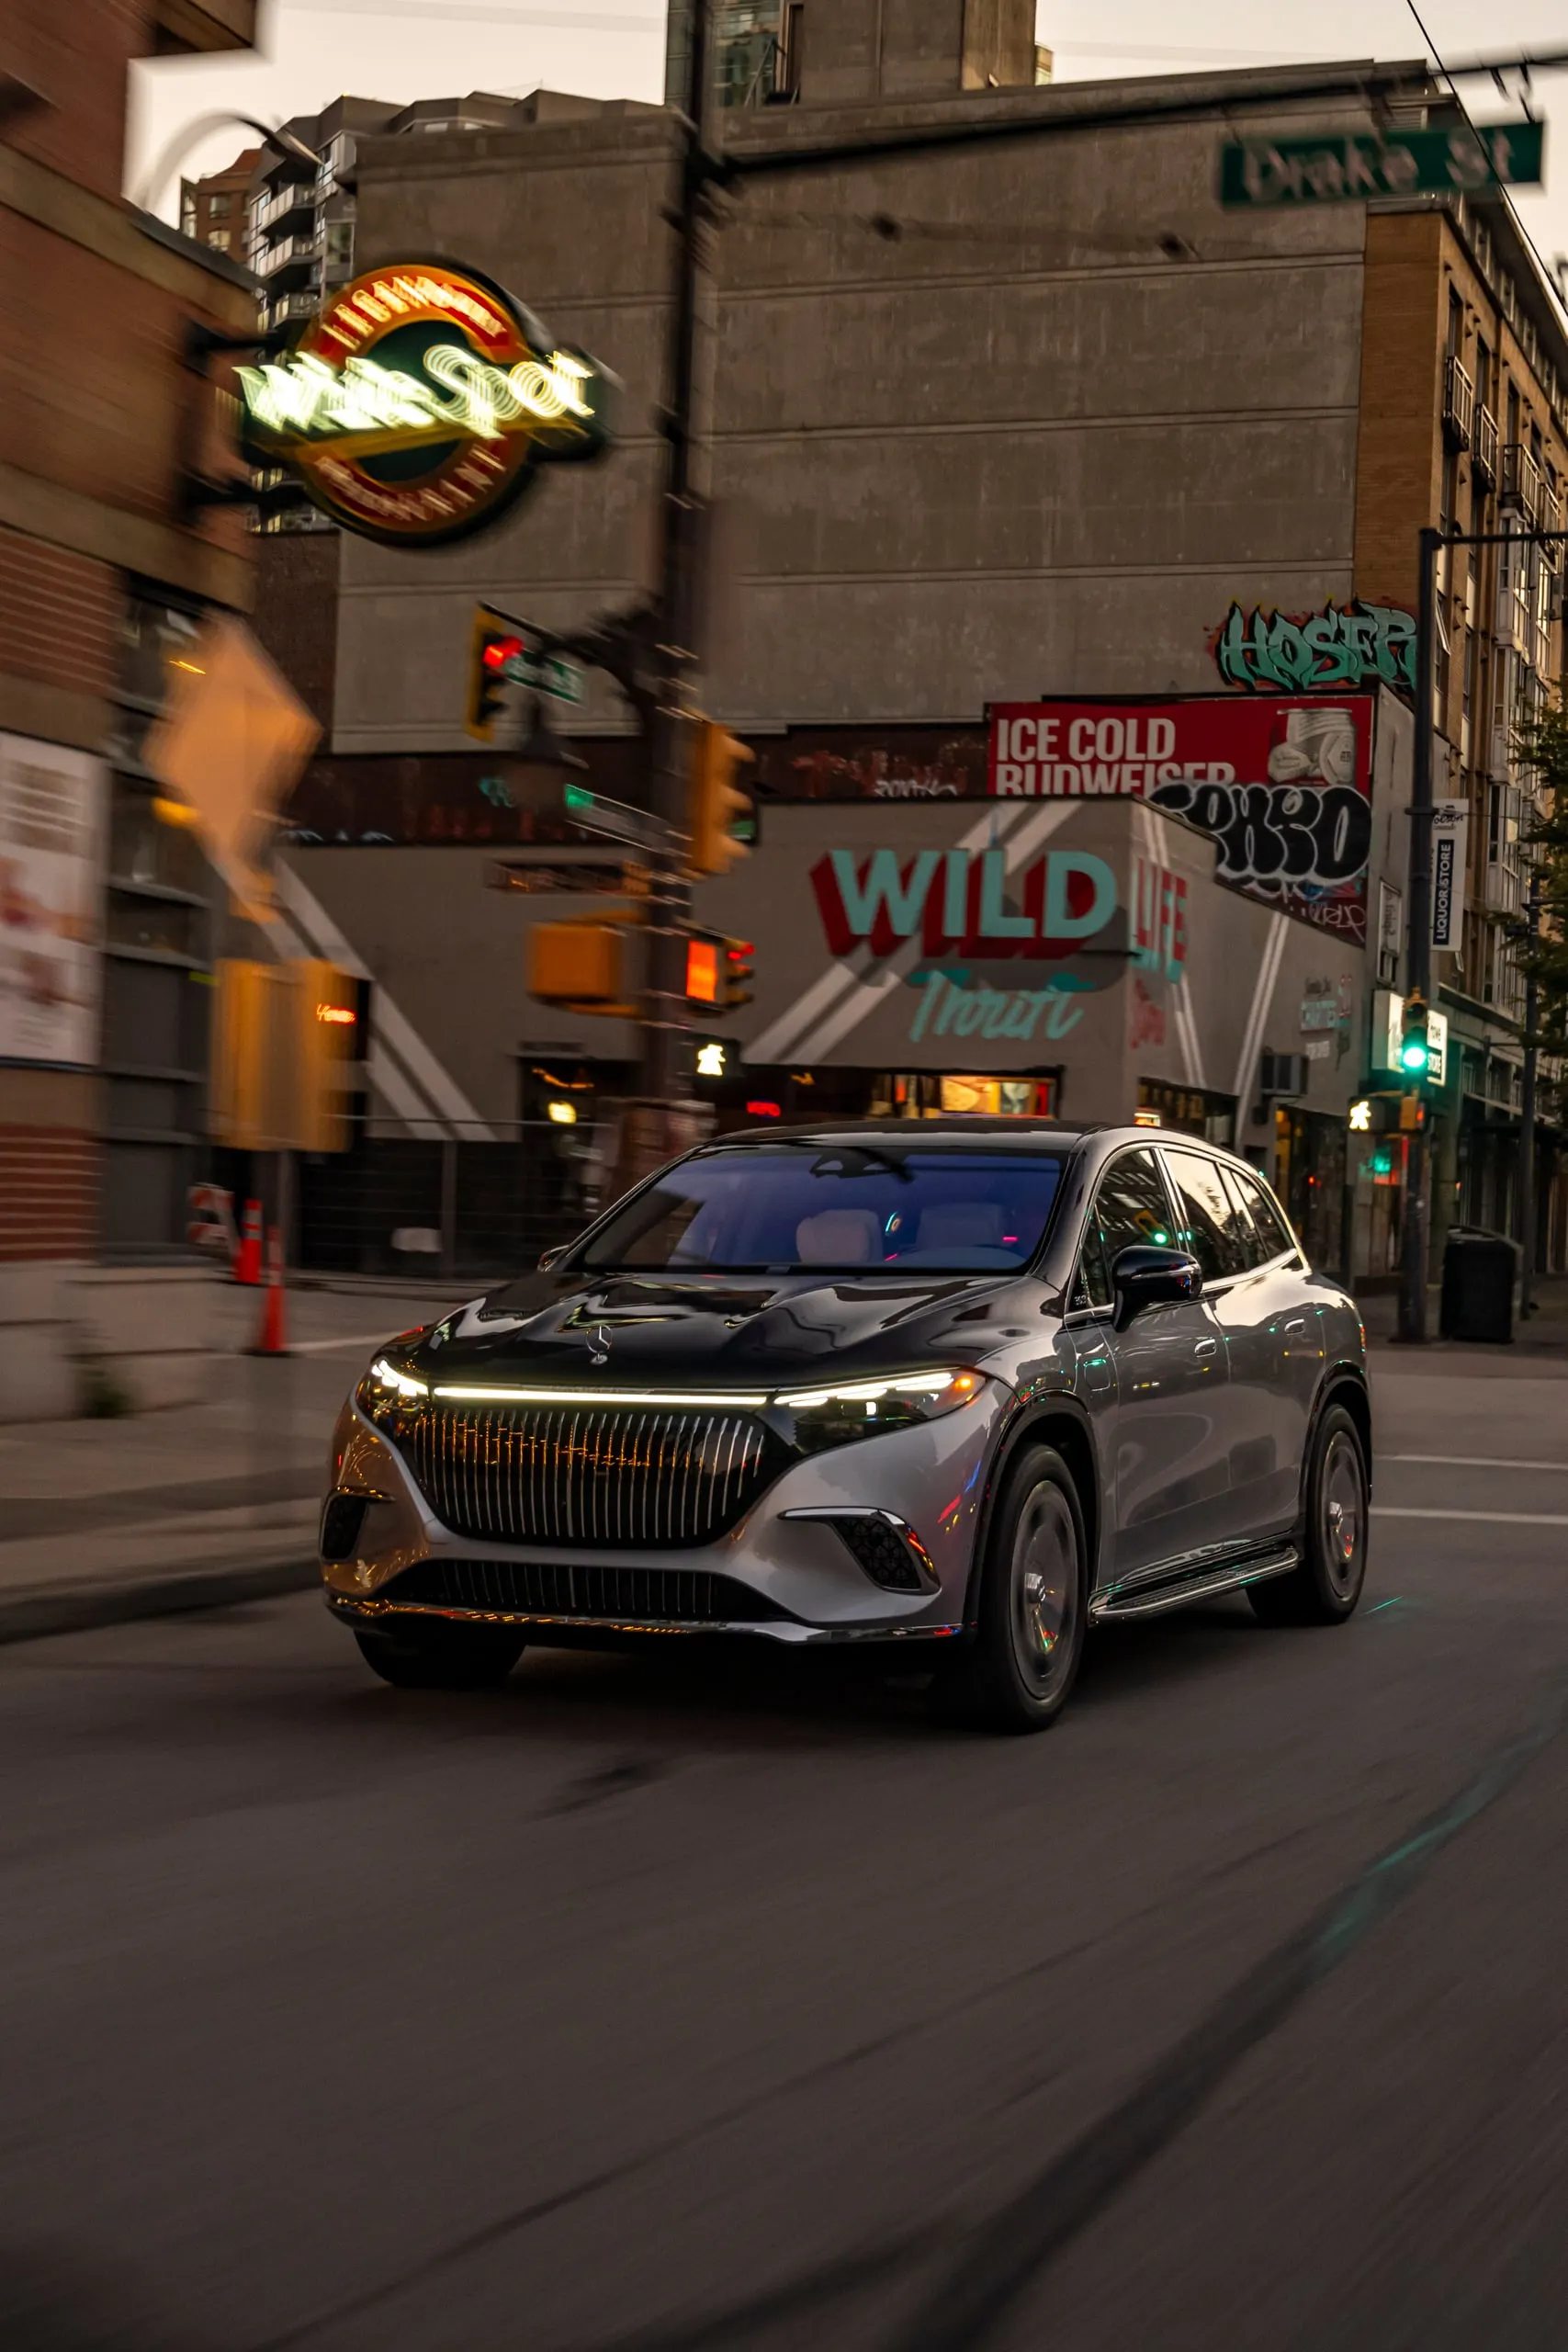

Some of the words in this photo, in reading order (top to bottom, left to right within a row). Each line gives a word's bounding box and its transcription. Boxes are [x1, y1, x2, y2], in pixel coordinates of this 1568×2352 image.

[1240, 136, 1420, 200] Drake
[1445, 127, 1514, 189] St
[423, 340, 595, 441] Spot
[996, 718, 1061, 763] ICE
[1068, 718, 1177, 763] COLD
[816, 849, 1118, 954] WILD
[1439, 842, 1452, 888] STORE
[1435, 888, 1450, 941] LIQUOR
[908, 967, 1097, 1044] Thrift
